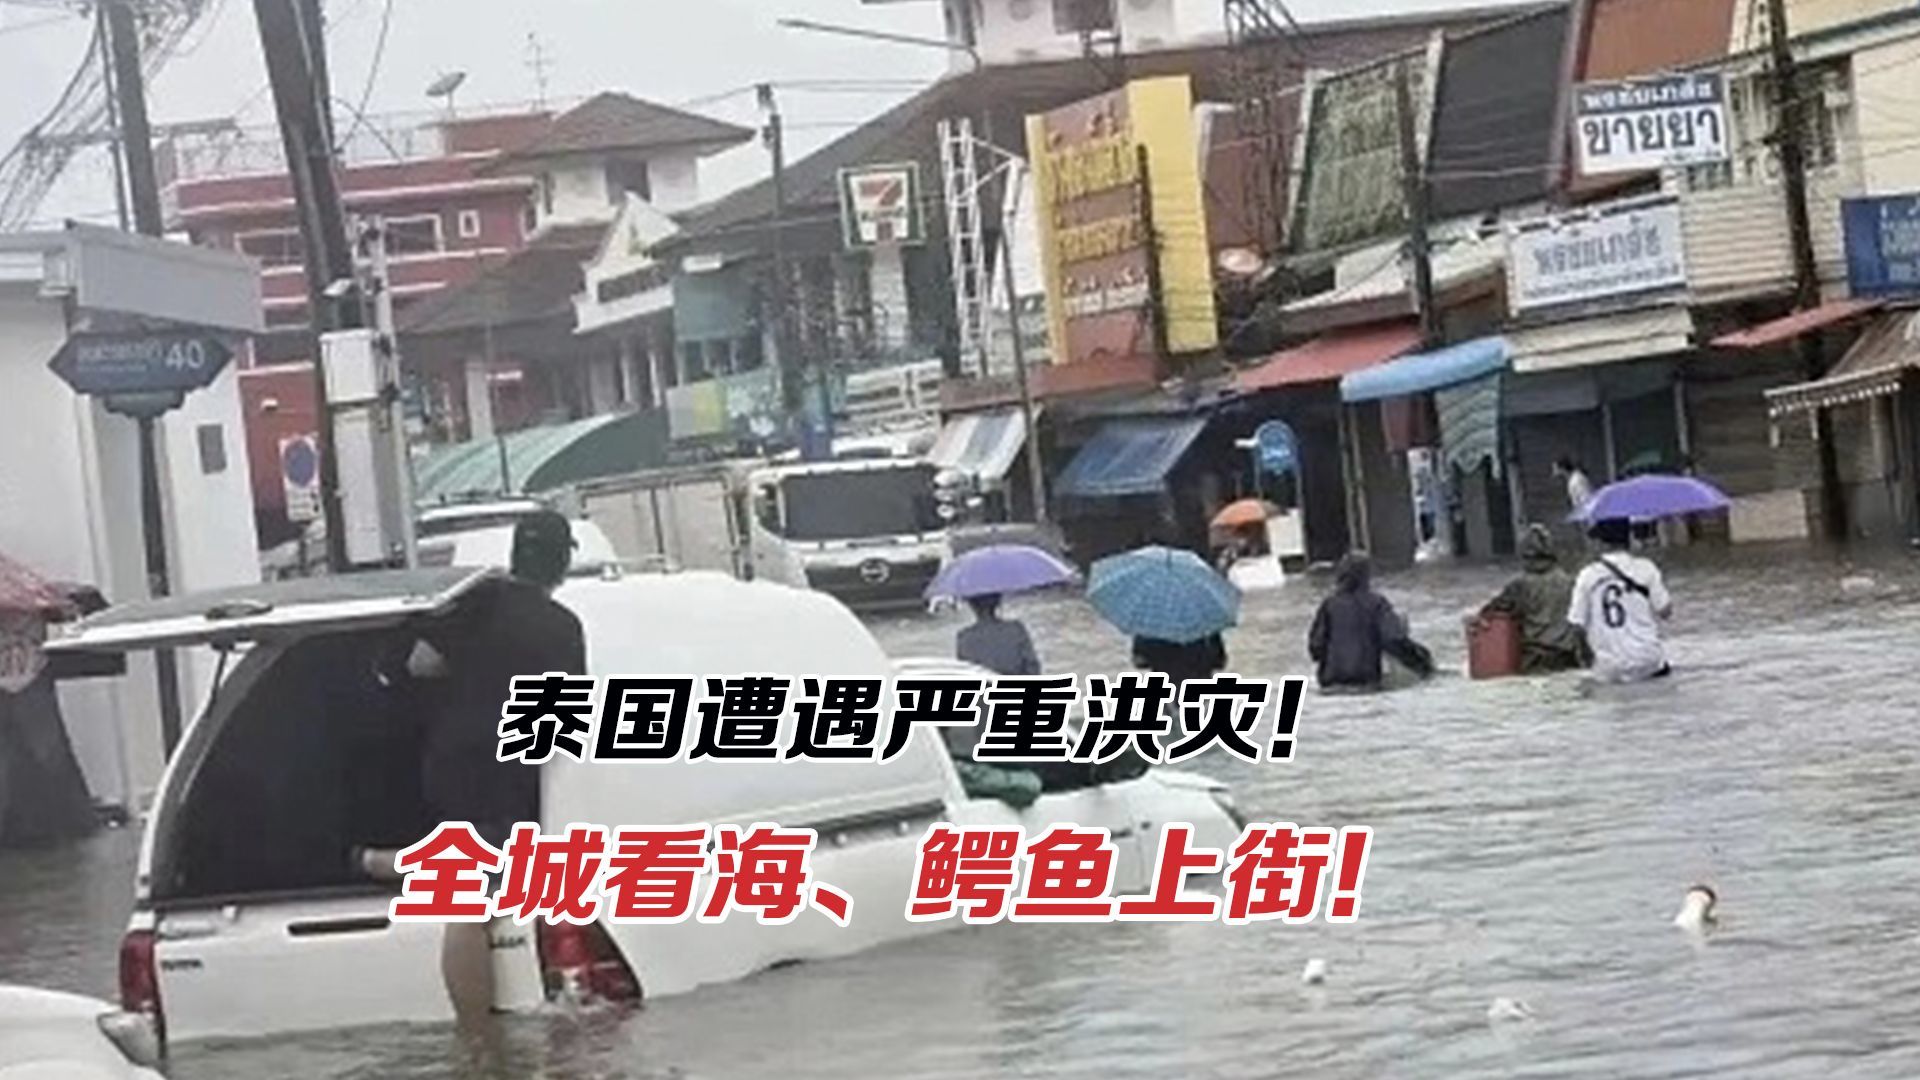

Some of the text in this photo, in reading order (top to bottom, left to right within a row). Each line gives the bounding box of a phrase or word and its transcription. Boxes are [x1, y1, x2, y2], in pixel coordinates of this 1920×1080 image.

[1584, 108, 1720, 156] ขายยา
[165, 339, 205, 370] 40
[1602, 583, 1626, 628] 6
